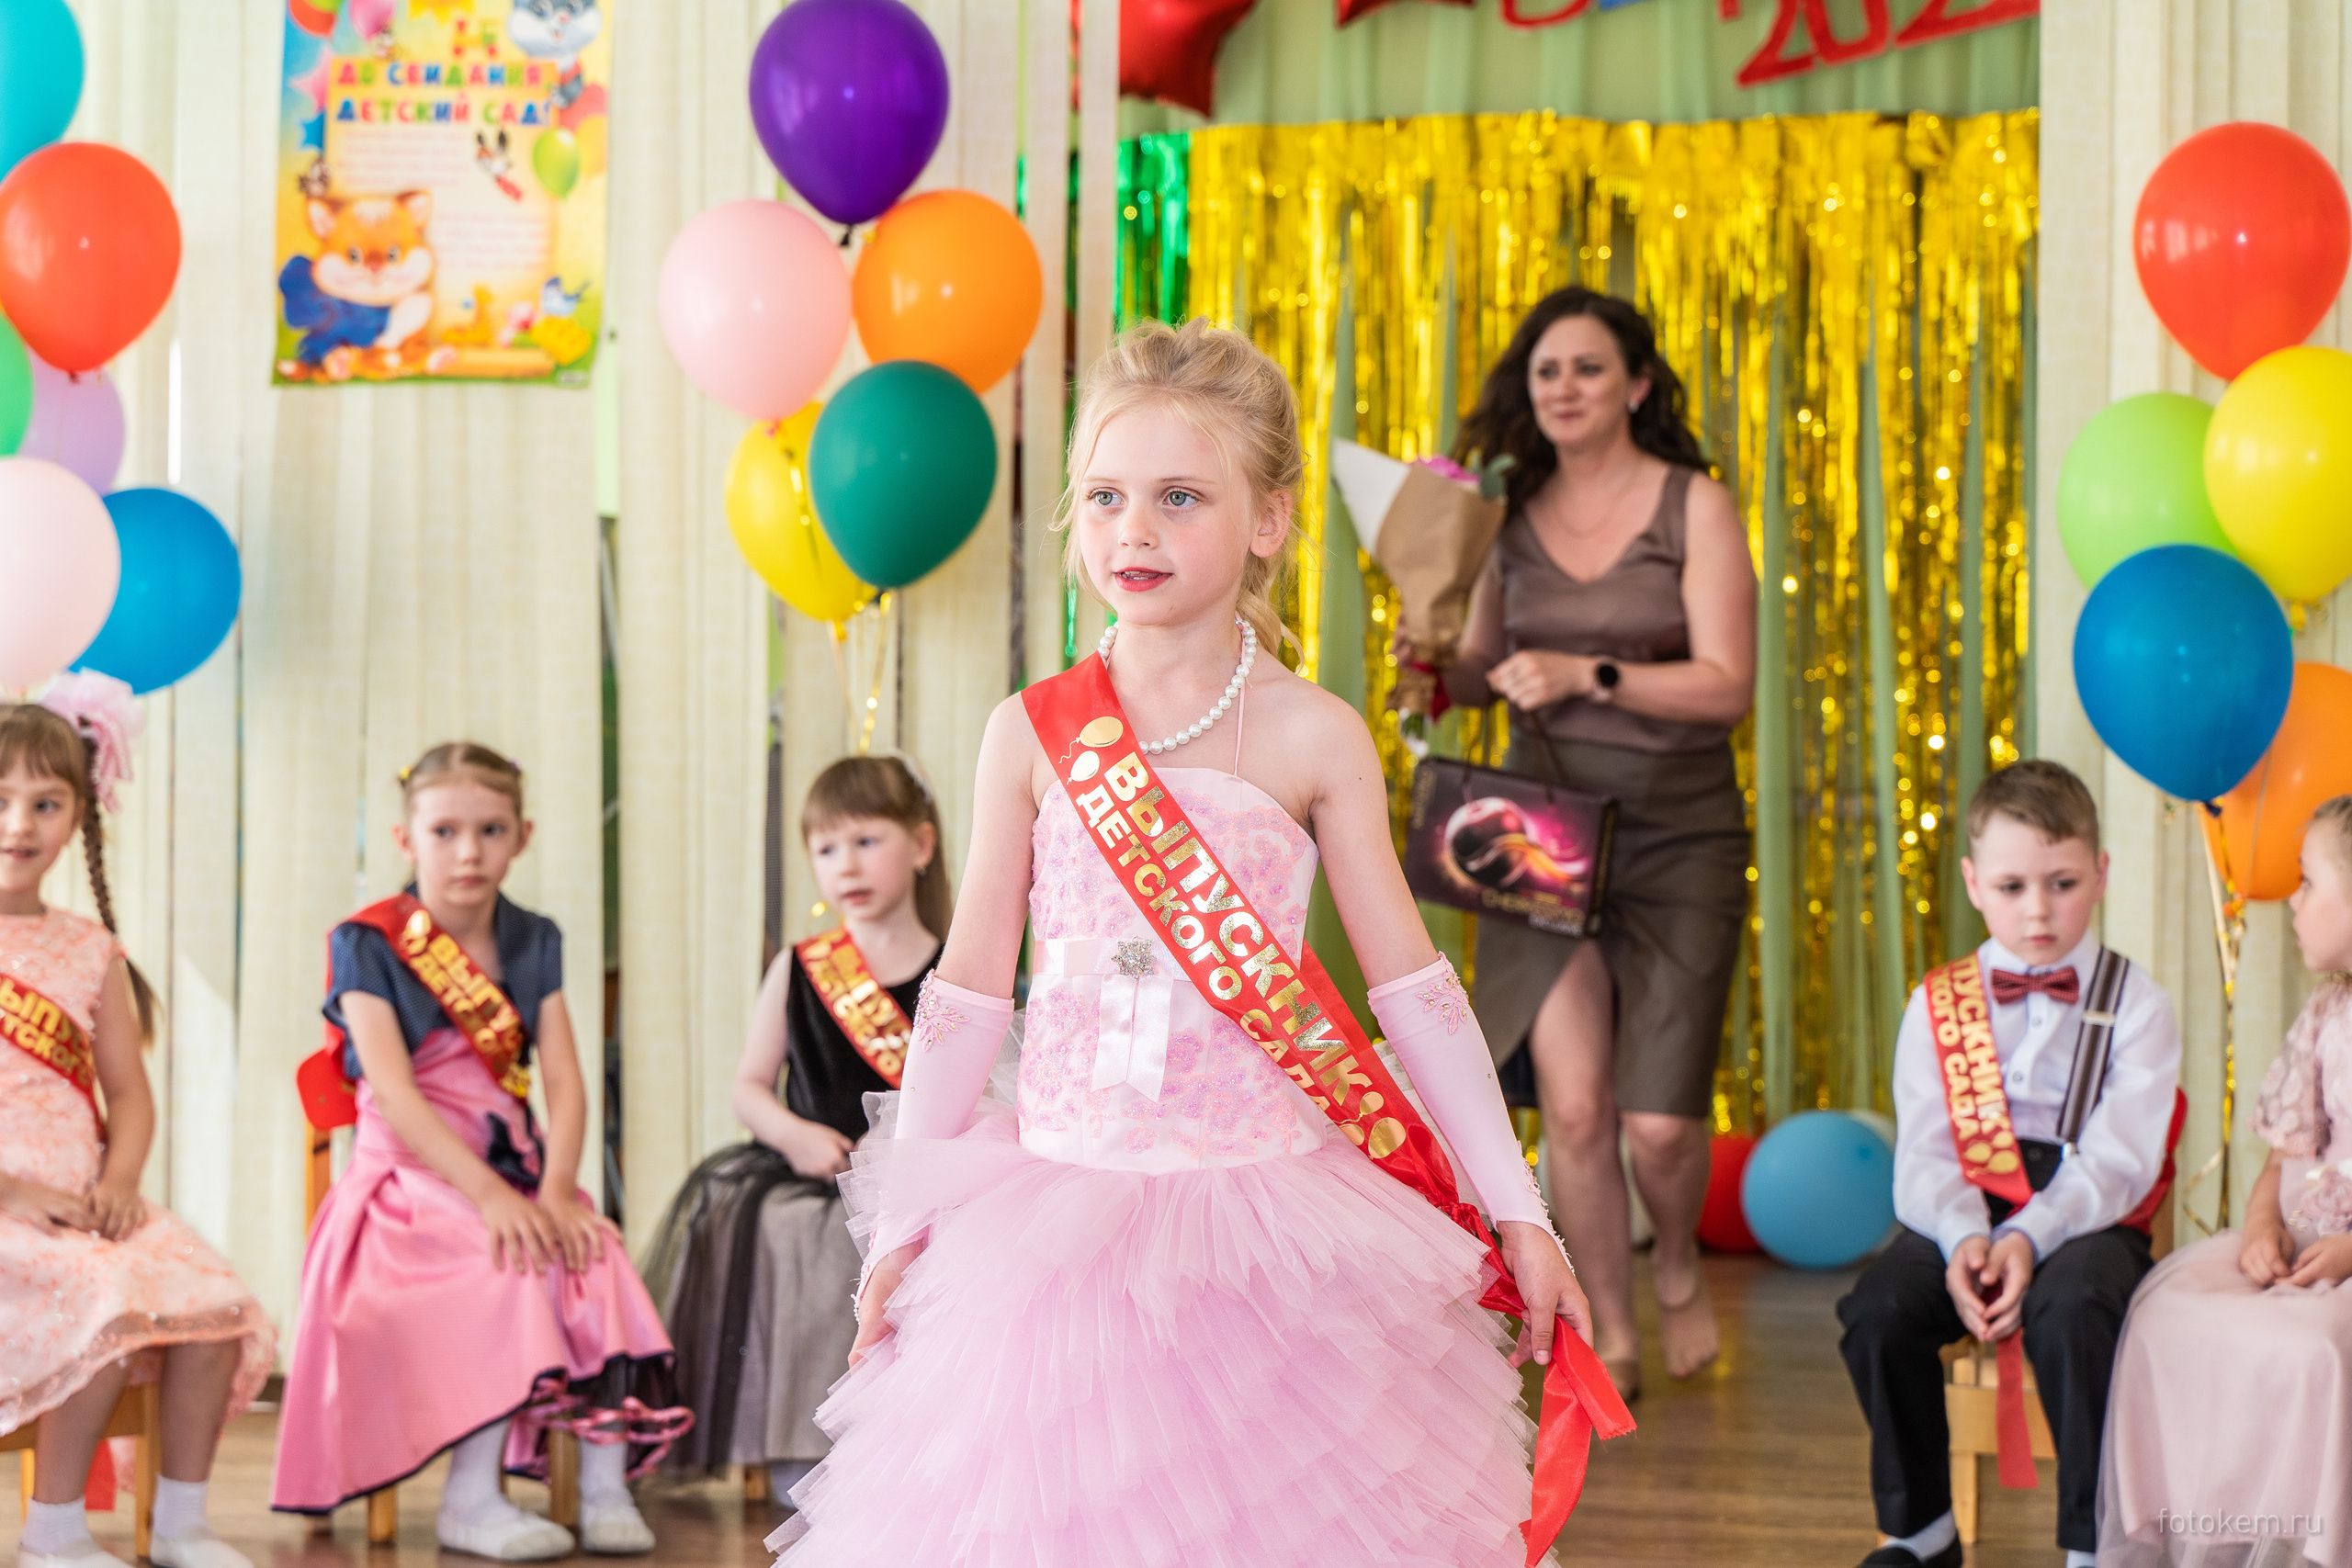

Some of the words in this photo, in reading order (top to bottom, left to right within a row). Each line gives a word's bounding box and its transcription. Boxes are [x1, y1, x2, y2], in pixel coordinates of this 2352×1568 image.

[336, 62, 377, 86] ДО
[336, 92, 469, 123] ДЕТСКИЙ
[1076, 784, 1243, 1000] ДЕТСКОГО
[1104, 751, 1373, 1106] ВЫПУСКНИК
[1944, 1053, 1980, 1141] САДА
